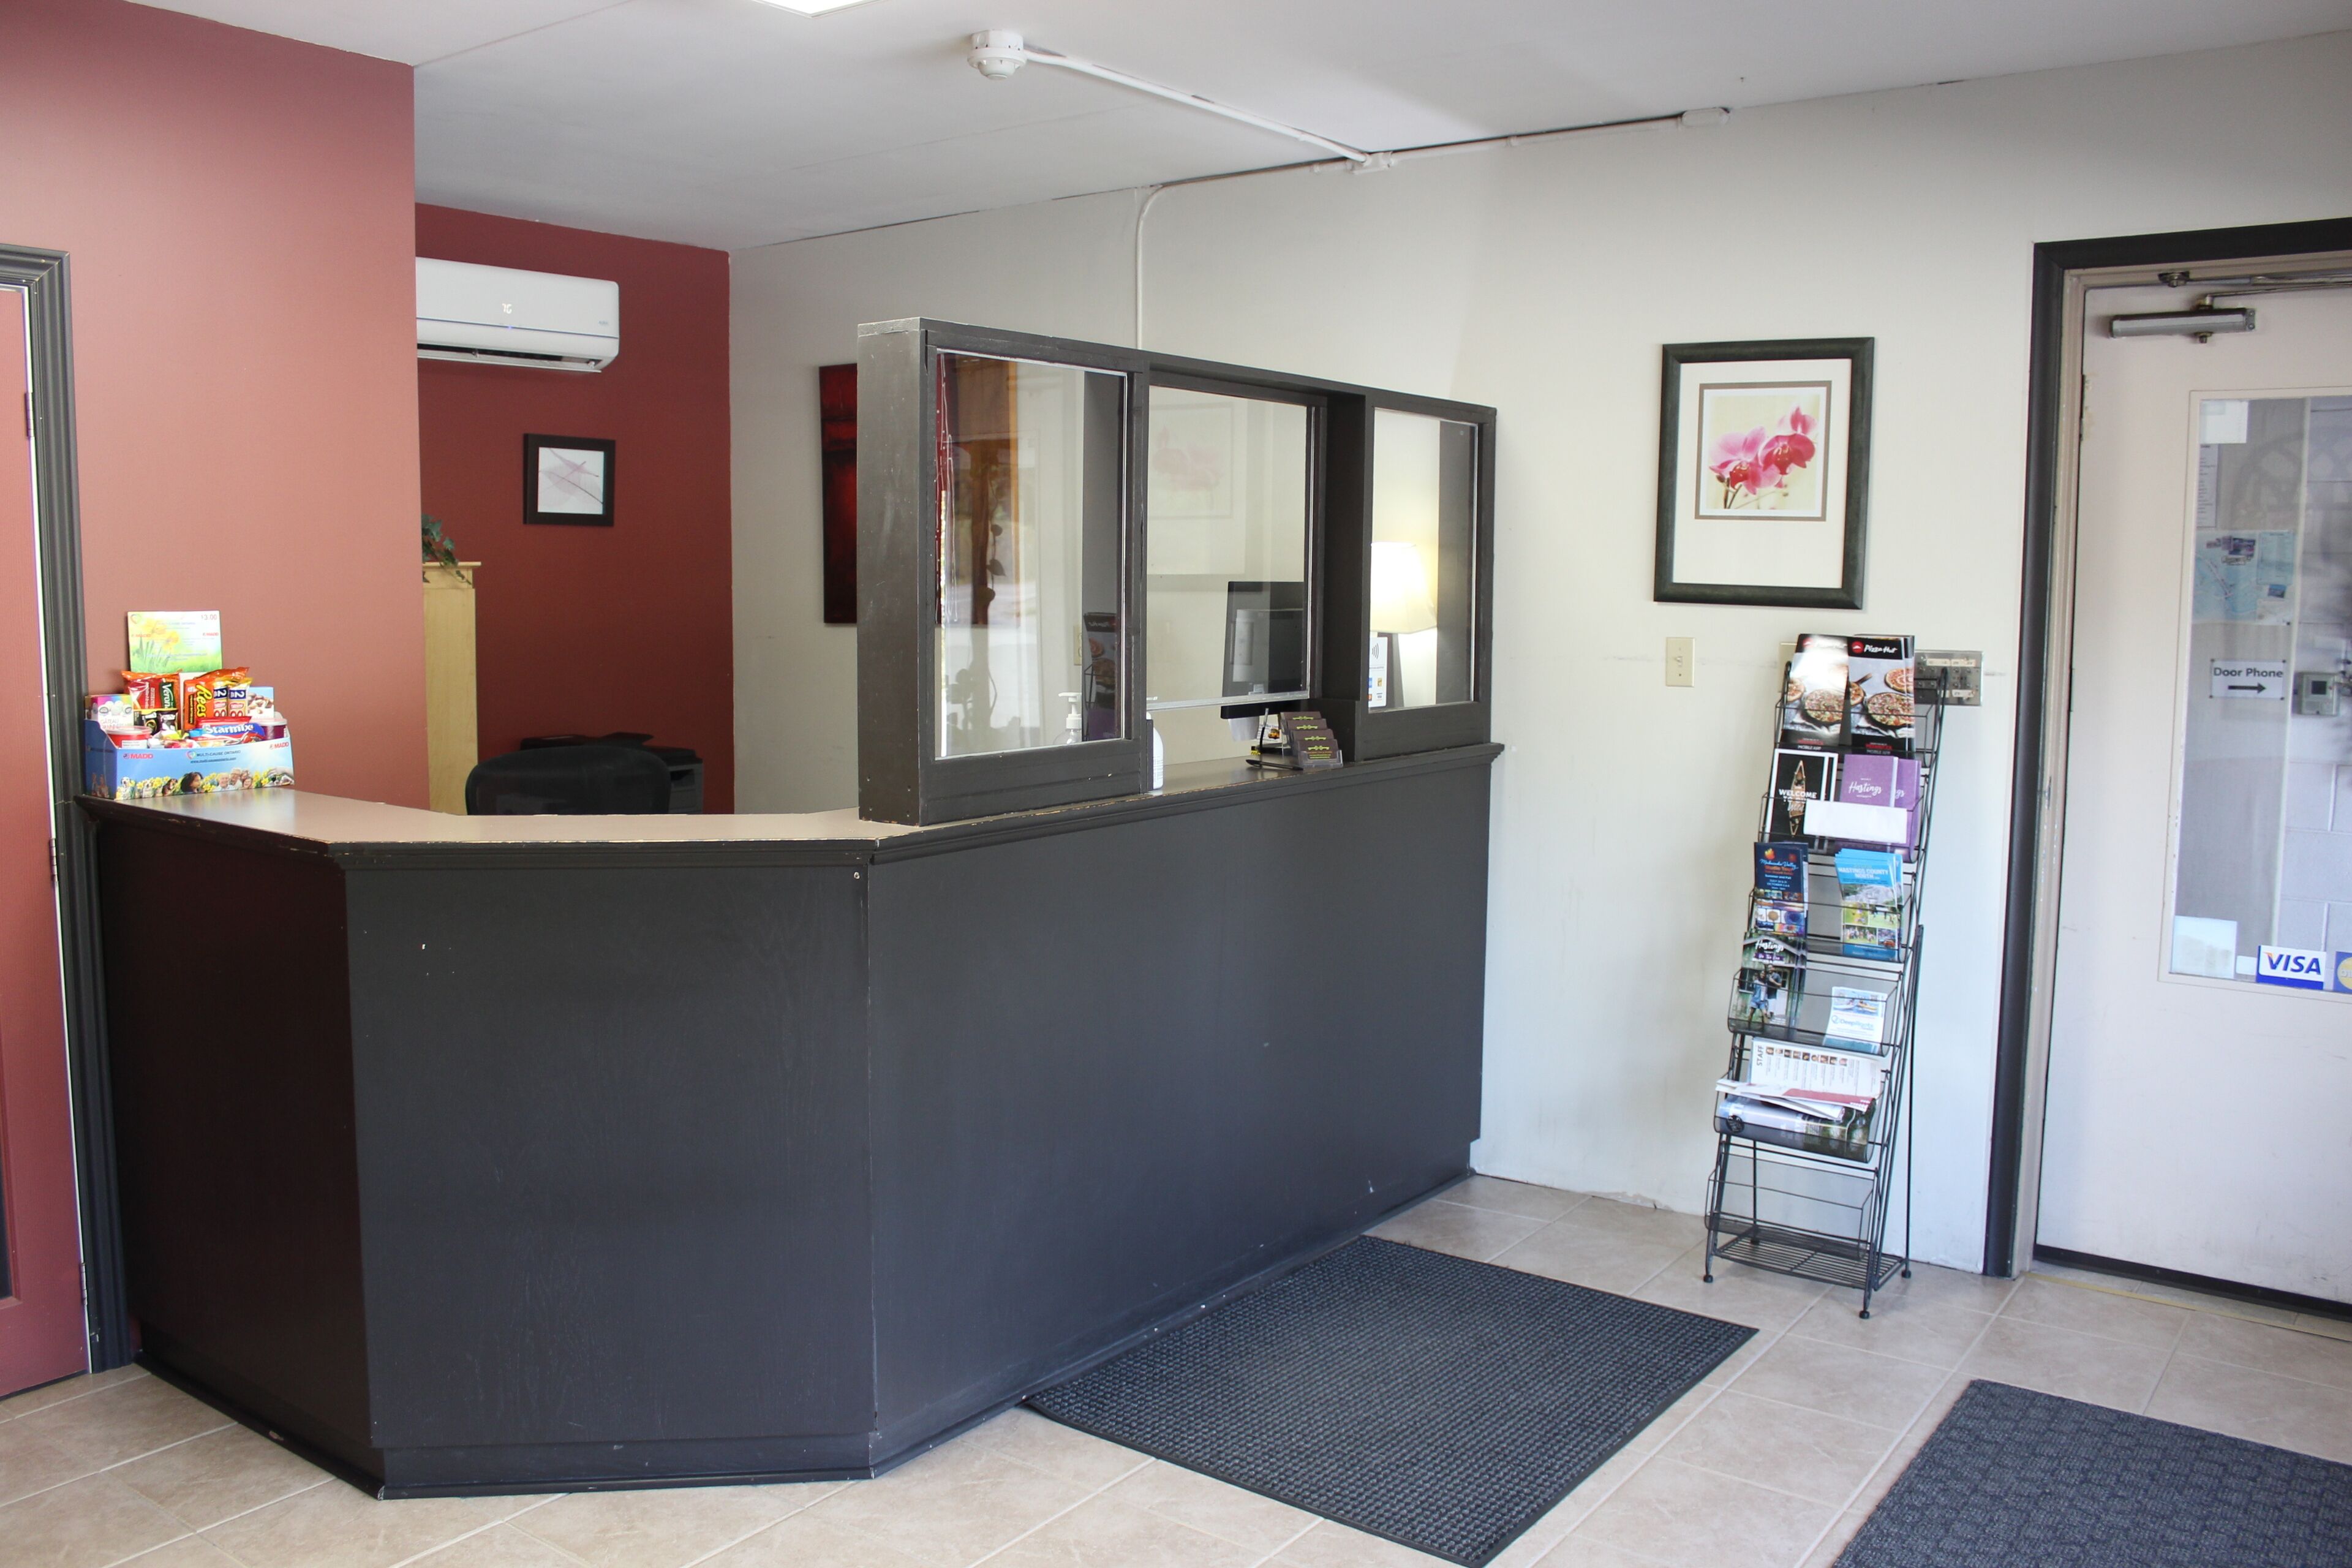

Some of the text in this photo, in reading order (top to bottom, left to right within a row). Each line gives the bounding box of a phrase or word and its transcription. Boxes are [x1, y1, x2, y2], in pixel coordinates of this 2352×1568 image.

[1864, 644, 1883, 653] Pizza
[2213, 667, 2284, 678] Door Phone
[162, 682, 174, 709] Veron
[195, 684, 213, 718] Rees
[1778, 788, 1818, 799] WELCOME
[1848, 780, 1882, 797] Hastings
[1755, 940, 1784, 953] Hastings
[2263, 952, 2321, 976] VISA
